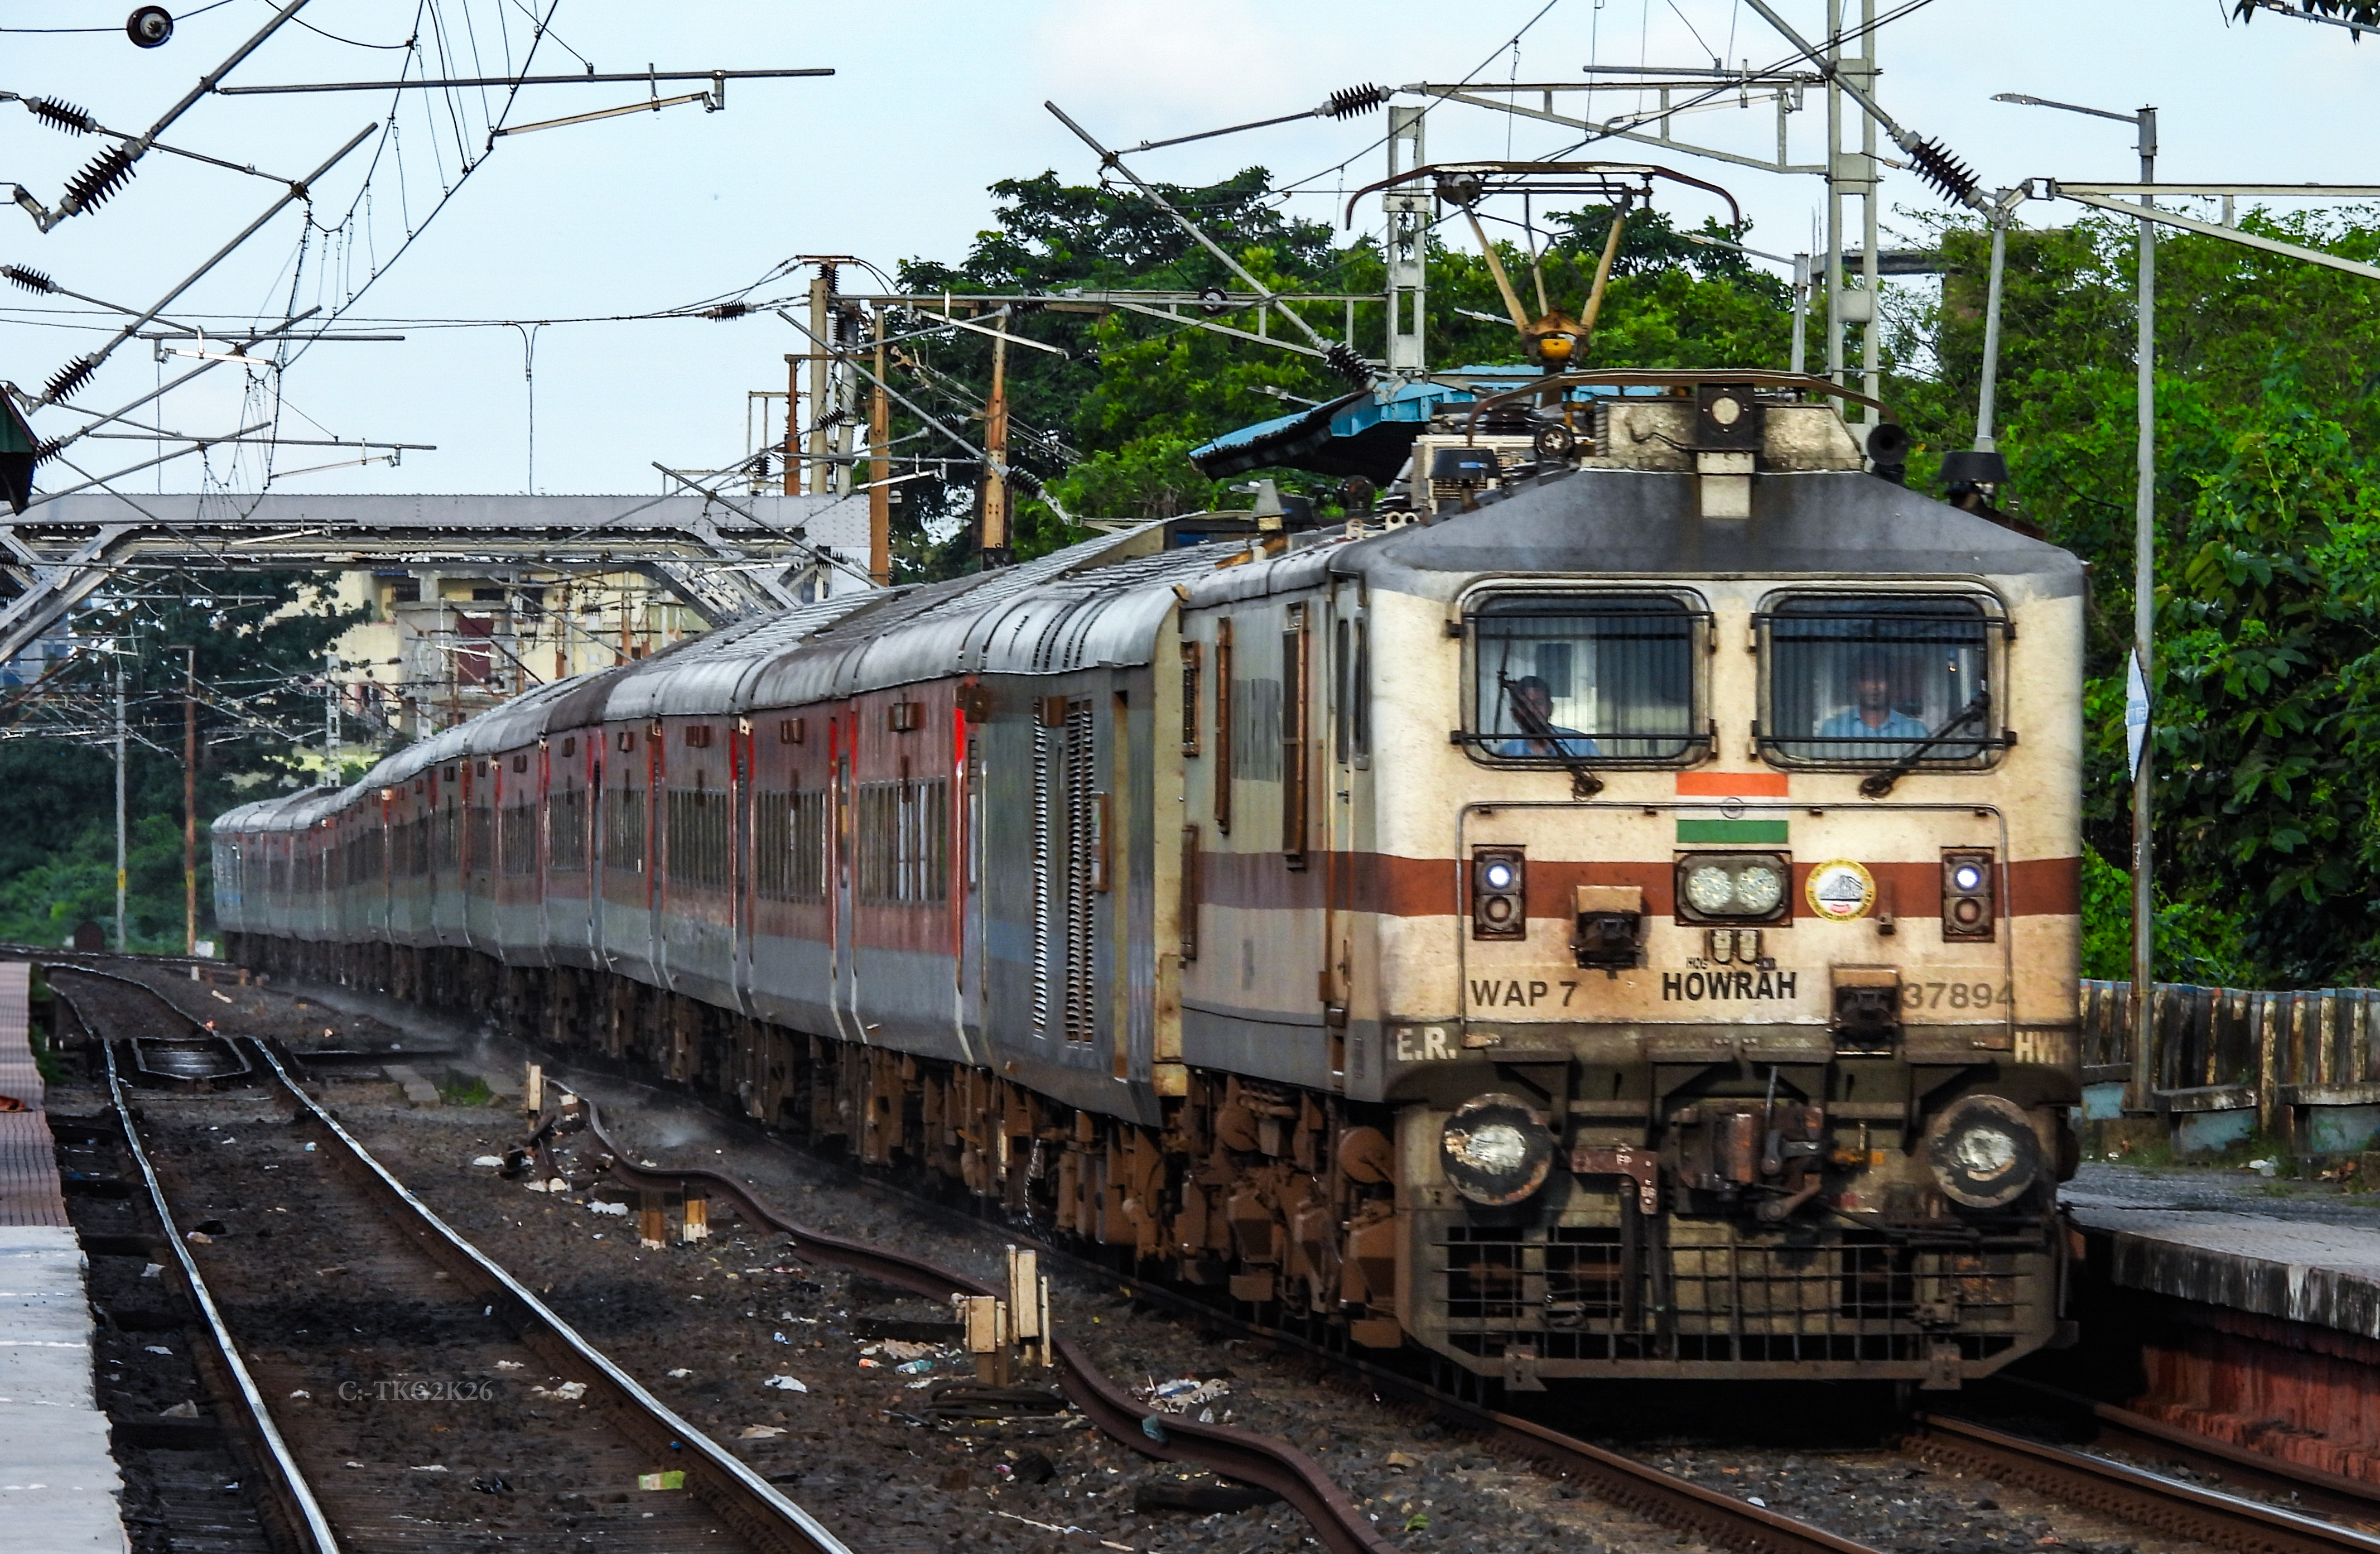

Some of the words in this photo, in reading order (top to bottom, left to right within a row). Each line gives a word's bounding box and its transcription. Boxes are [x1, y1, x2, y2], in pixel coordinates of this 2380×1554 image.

[1470, 979, 1548, 1007] WAP
[1559, 980, 1580, 1007] 7
[1661, 971, 1796, 1001] HOWRAH
[1396, 1026, 1457, 1061] E.R.
